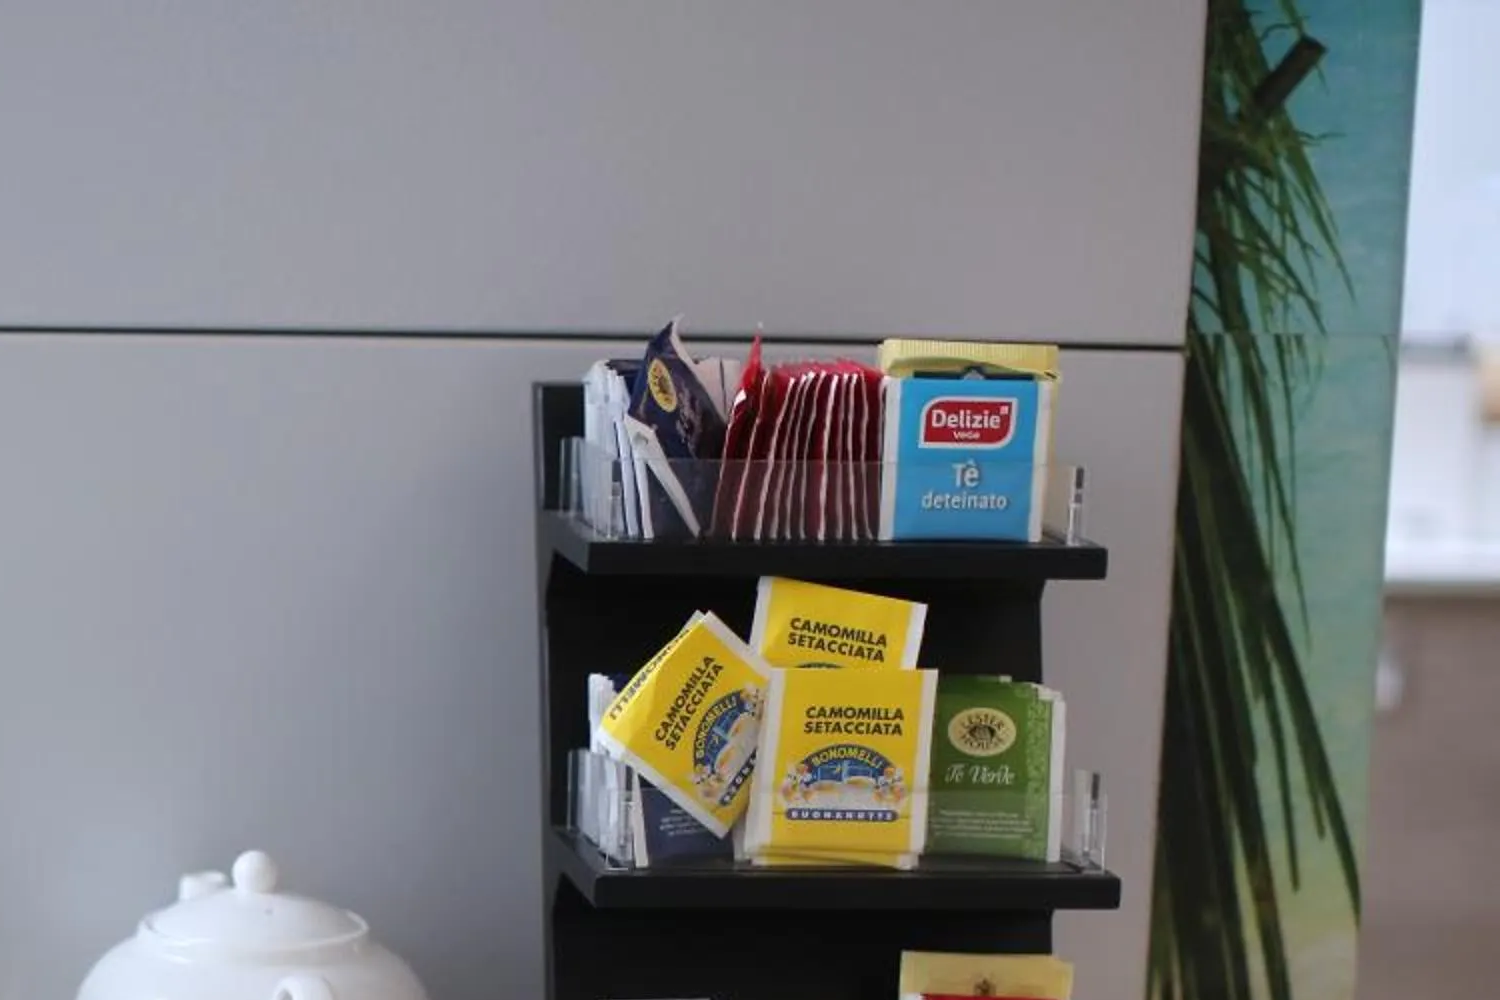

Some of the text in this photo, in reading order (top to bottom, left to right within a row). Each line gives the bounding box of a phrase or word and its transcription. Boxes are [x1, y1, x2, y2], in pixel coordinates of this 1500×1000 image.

[931, 409, 1001, 429] Delizie
[921, 490, 1008, 509] deteinato
[789, 617, 888, 649] CAMOMILLA
[787, 631, 885, 663] SETACCIATA
[654, 655, 716, 742] CAMOMILLA
[664, 664, 725, 751] SETACCIATA
[805, 706, 905, 721] CAMOMILLA
[803, 721, 903, 737] SETACCIATA
[810, 746, 885, 769] BONOMELLI
